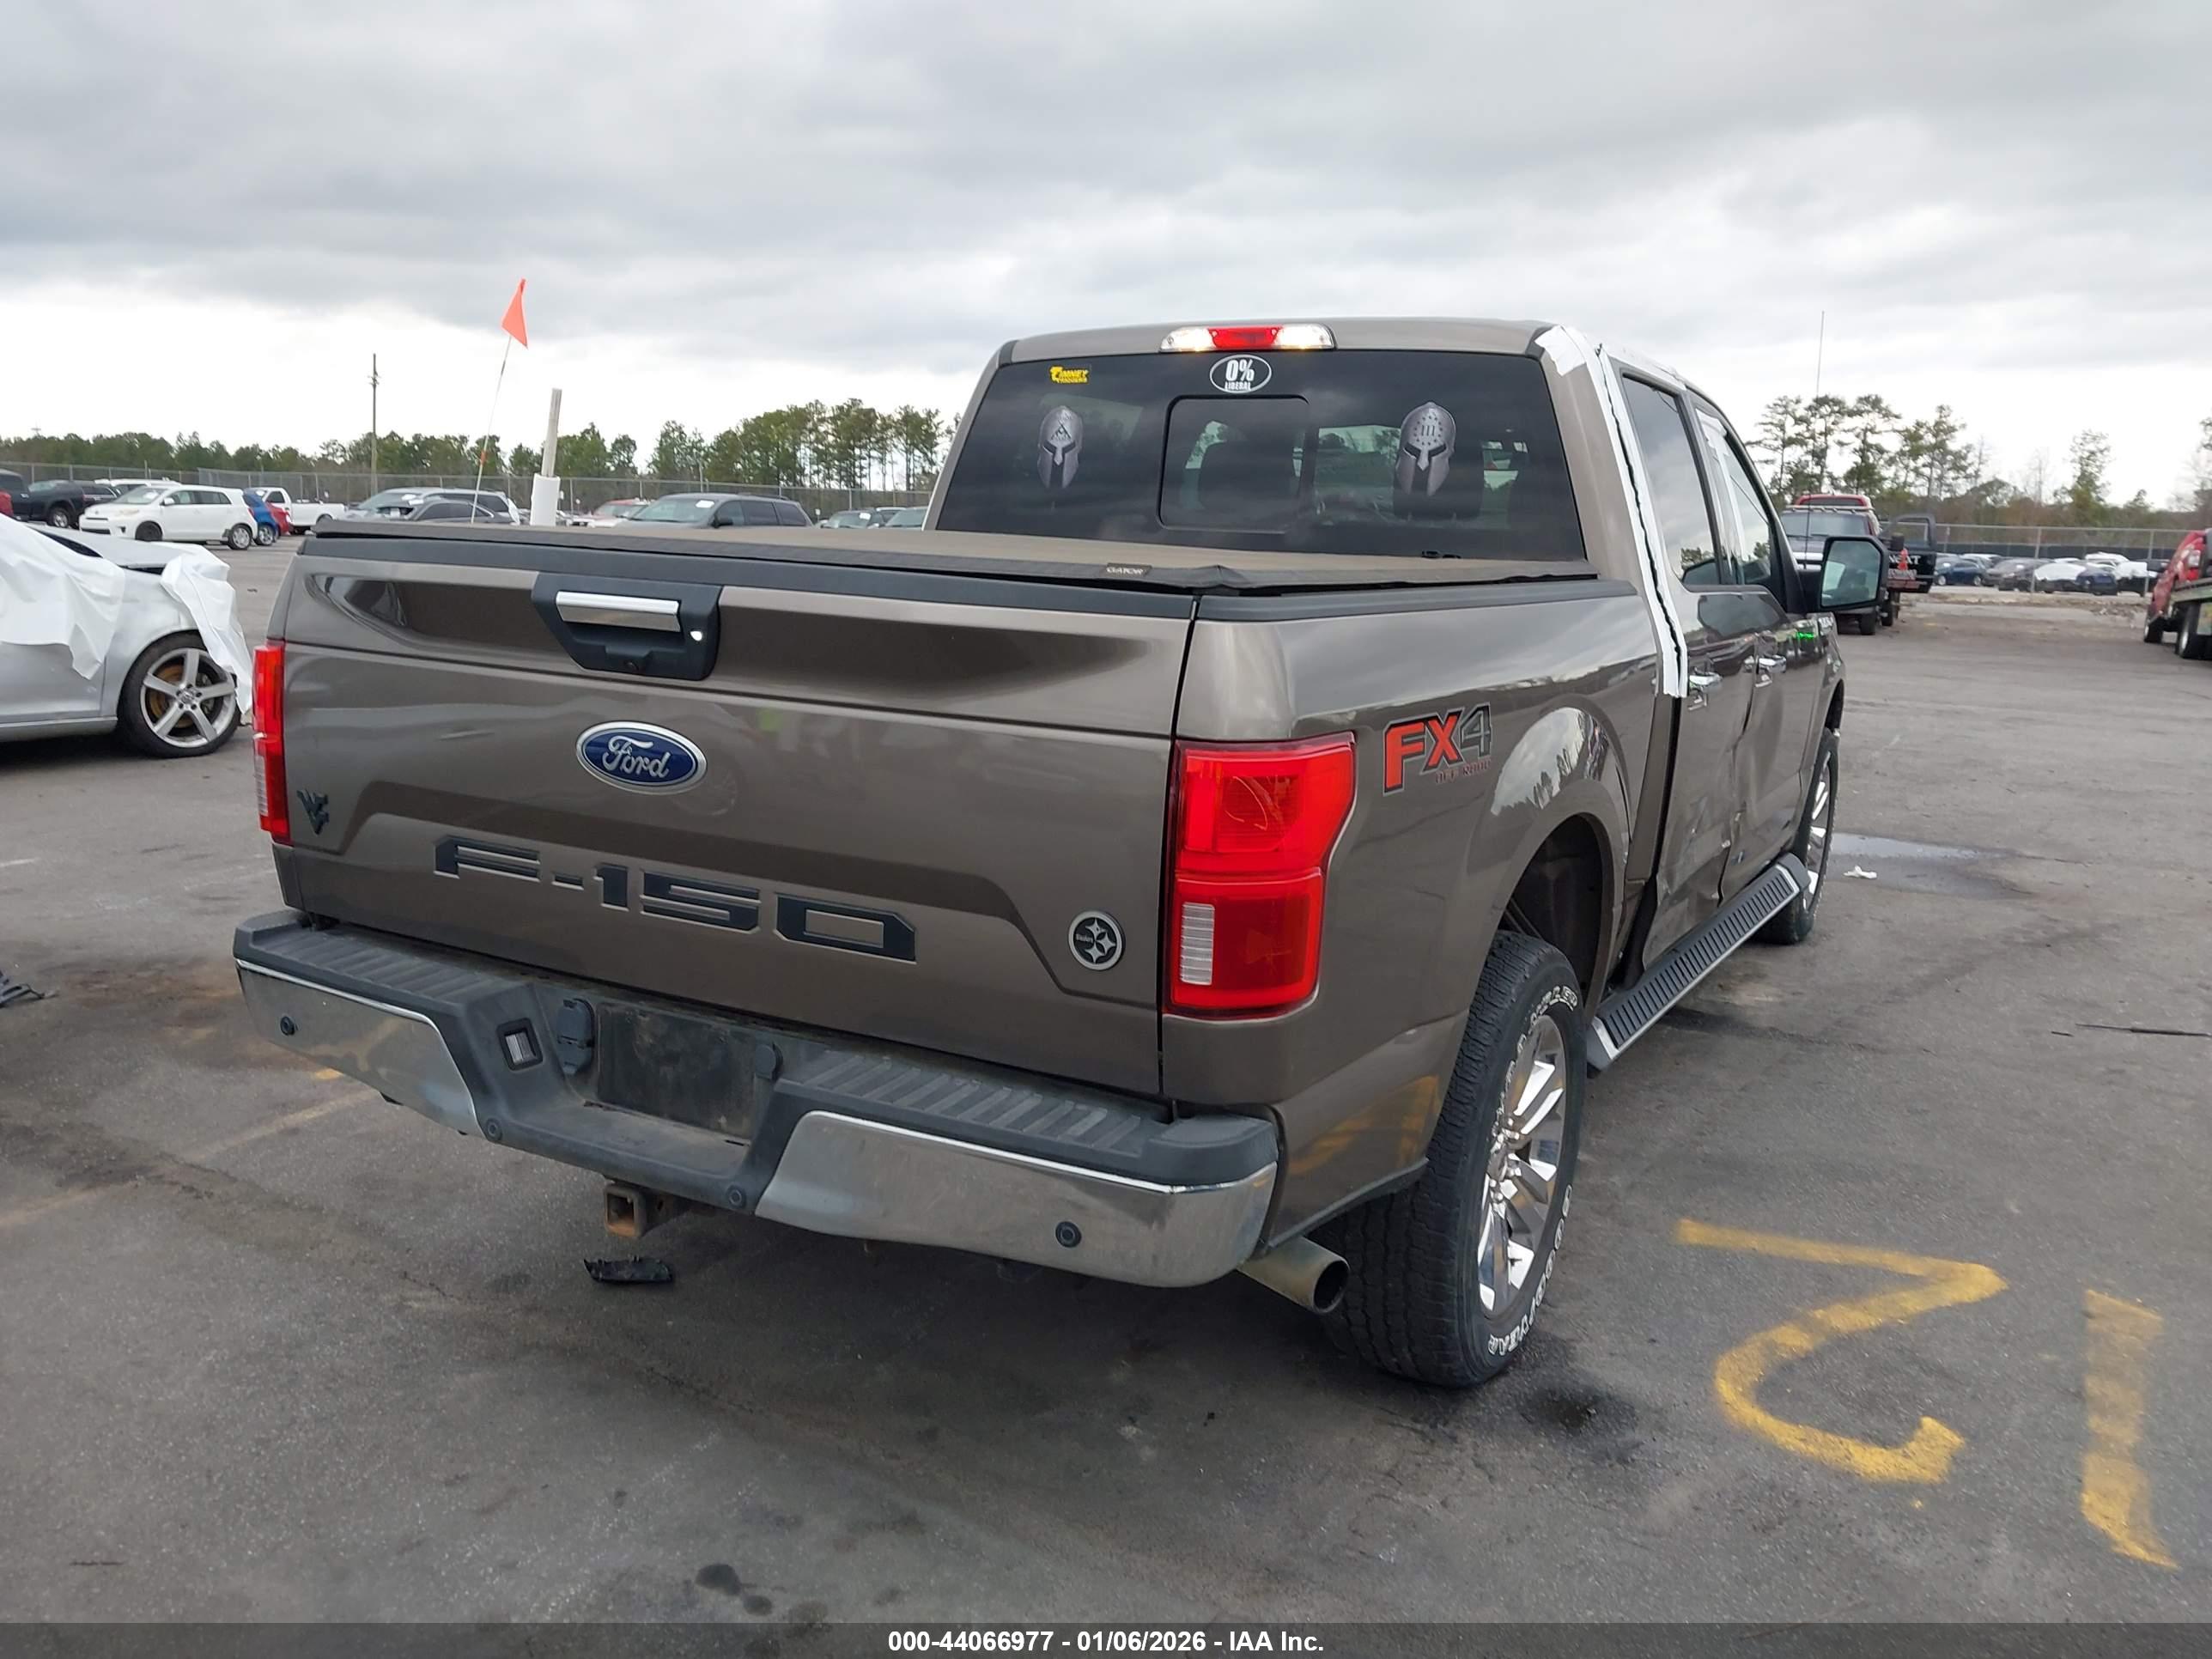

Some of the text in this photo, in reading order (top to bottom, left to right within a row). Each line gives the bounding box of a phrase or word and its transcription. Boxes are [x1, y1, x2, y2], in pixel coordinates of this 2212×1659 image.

[1225, 359, 1255, 381] 0%
[602, 735, 671, 778] Ford
[1383, 702, 1492, 796] FX4
[434, 836, 916, 963] F-150
